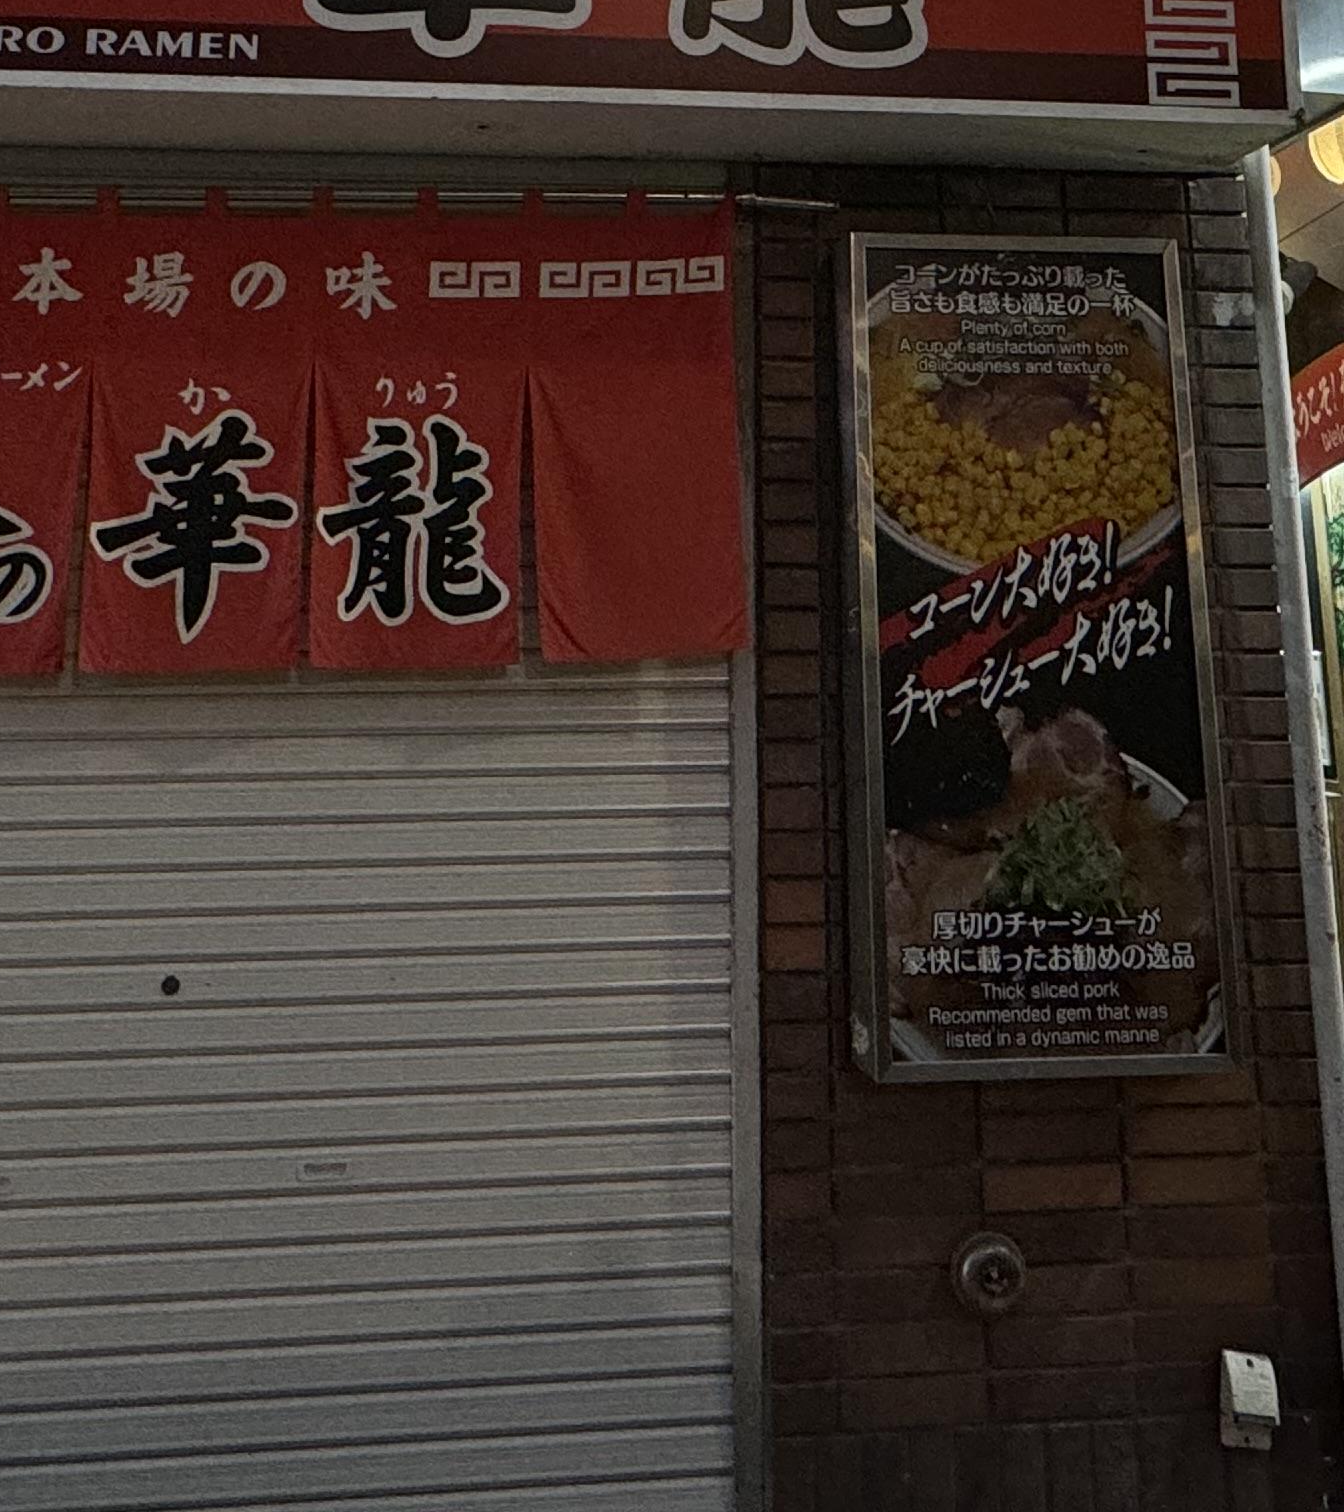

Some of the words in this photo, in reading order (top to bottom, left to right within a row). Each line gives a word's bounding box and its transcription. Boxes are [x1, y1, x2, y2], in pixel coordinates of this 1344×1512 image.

[86, 29, 260, 61] RAMEN
[10, 248, 399, 319] 本場の味
[890, 290, 1137, 317] 旨さも食感も満足の一杯
[961, 320, 1007, 337] Plenty
[1033, 323, 1067, 336] corn
[899, 338, 912, 353] A
[916, 341, 944, 358] cup
[967, 339, 1056, 355] satisfaction
[1060, 340, 1091, 355] with
[1096, 340, 1129, 356] both
[919, 358, 1021, 374] deliciousness
[1025, 359, 1052, 374] and
[1058, 360, 1112, 375] texture
[372, 372, 462, 412] りゅう
[91, 403, 510, 643] 華龍
[932, 908, 1162, 940] 厚切りチャーシューが
[902, 942, 1196, 976] 豪快に載ったお勧めの逸品
[981, 982, 1026, 999] Thick
[1032, 982, 1080, 999] sliced
[1084, 981, 1120, 1000] pork
[929, 1006, 1051, 1025] Recommended
[1056, 1008, 1092, 1026] gem
[1097, 1004, 1130, 1020] that
[1136, 1006, 1168, 1020] was
[946, 1030, 991, 1048] listed
[1032, 1028, 1100, 1049] dynamic
